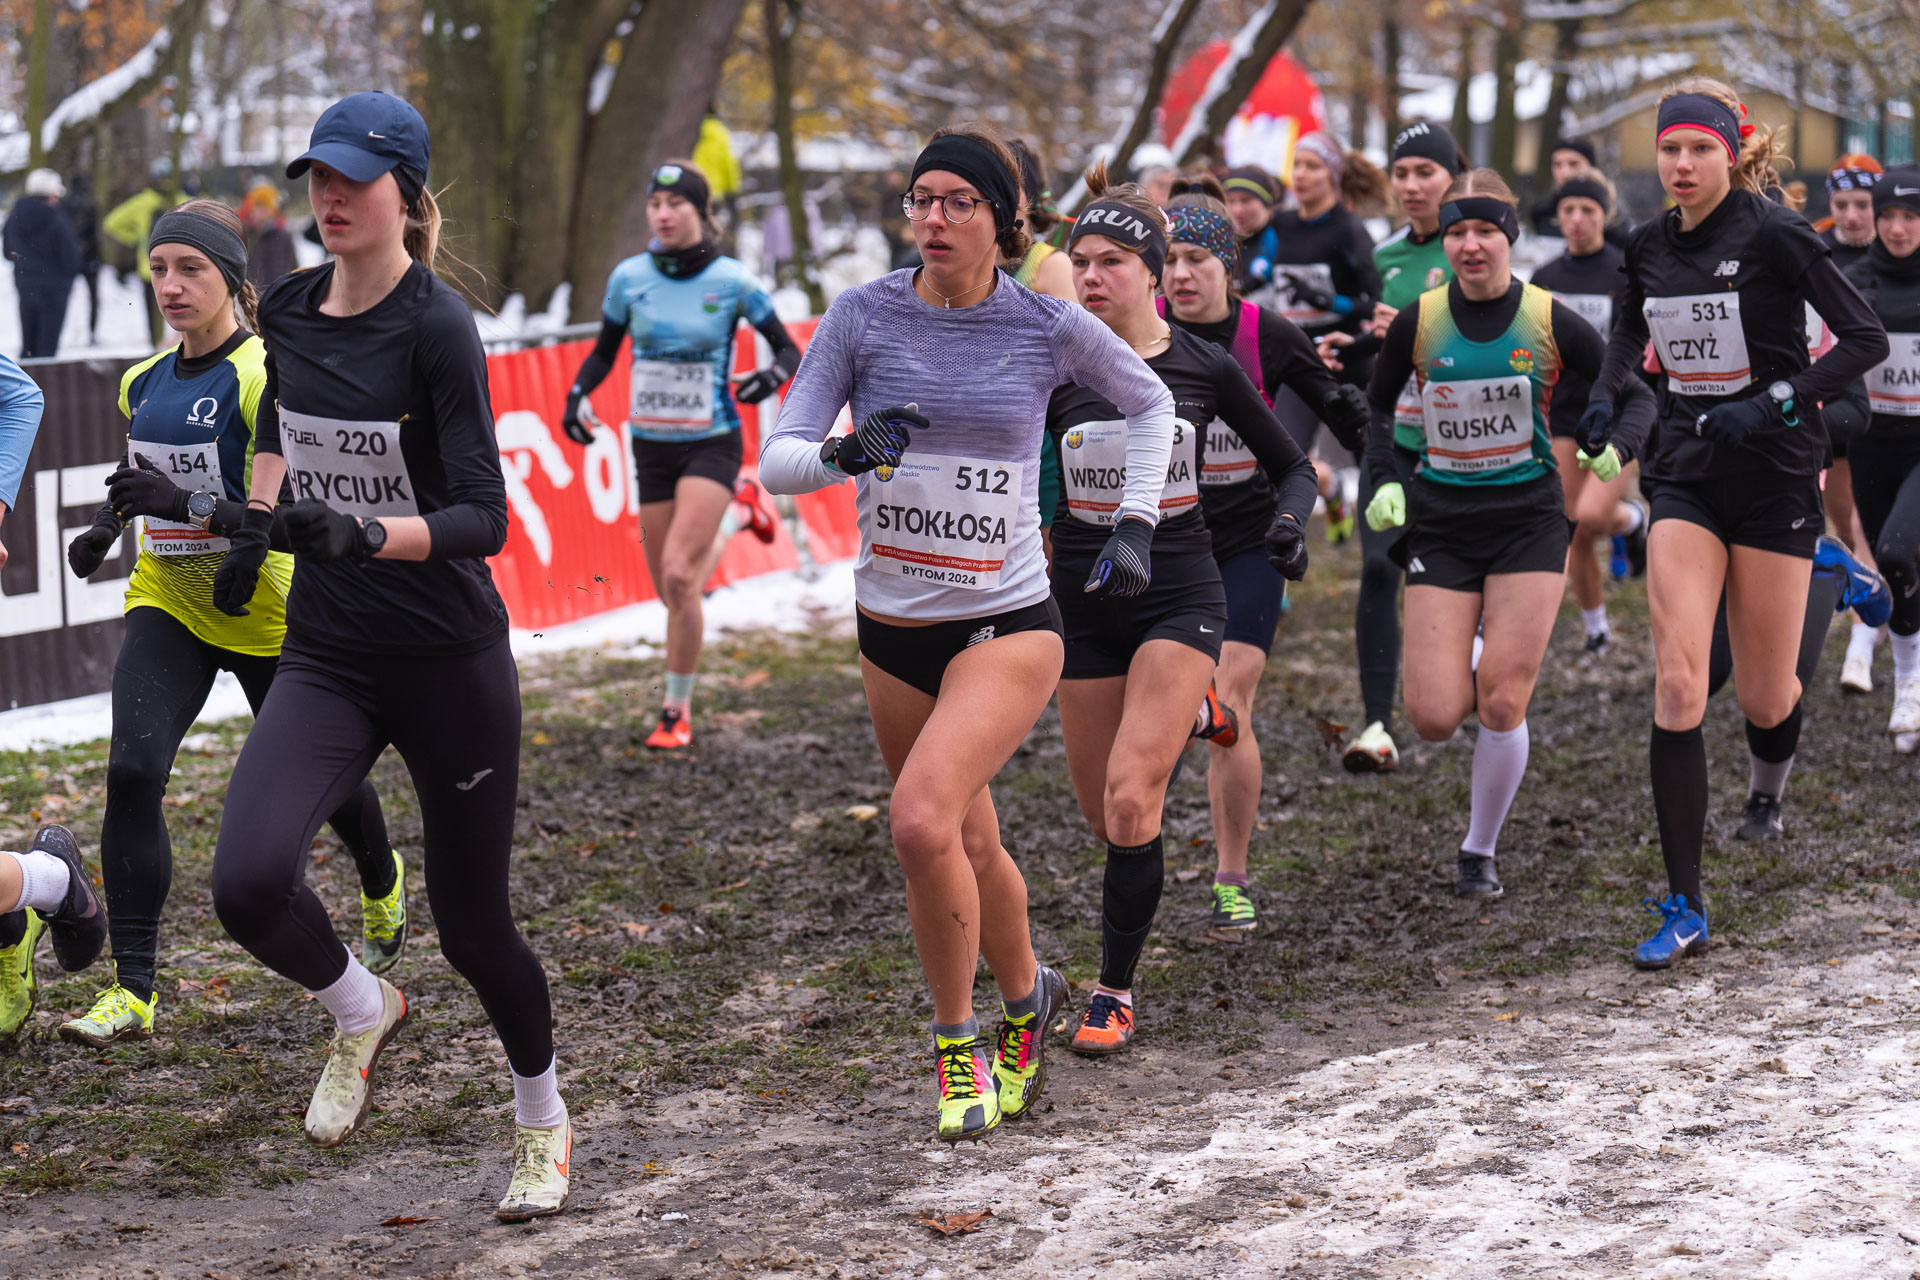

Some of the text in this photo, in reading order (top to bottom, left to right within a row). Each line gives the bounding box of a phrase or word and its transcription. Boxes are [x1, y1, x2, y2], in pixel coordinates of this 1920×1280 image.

[1081, 209, 1152, 240] RUN
[1692, 301, 1730, 322] 531
[1668, 332, 1720, 361] CZYŻ
[1482, 383, 1521, 403] 114
[1437, 413, 1517, 440] GUSKA
[288, 428, 323, 448] FUEL
[336, 429, 388, 456] 220
[169, 452, 208, 475] 154
[900, 469, 920, 478] Śląskie
[901, 462, 940, 472] Województwo
[955, 465, 1010, 495] 512
[876, 503, 1006, 544] STOKŁOSA
[153, 542, 210, 553] YTOM 2024
[902, 565, 977, 586] BYTOM 2024
